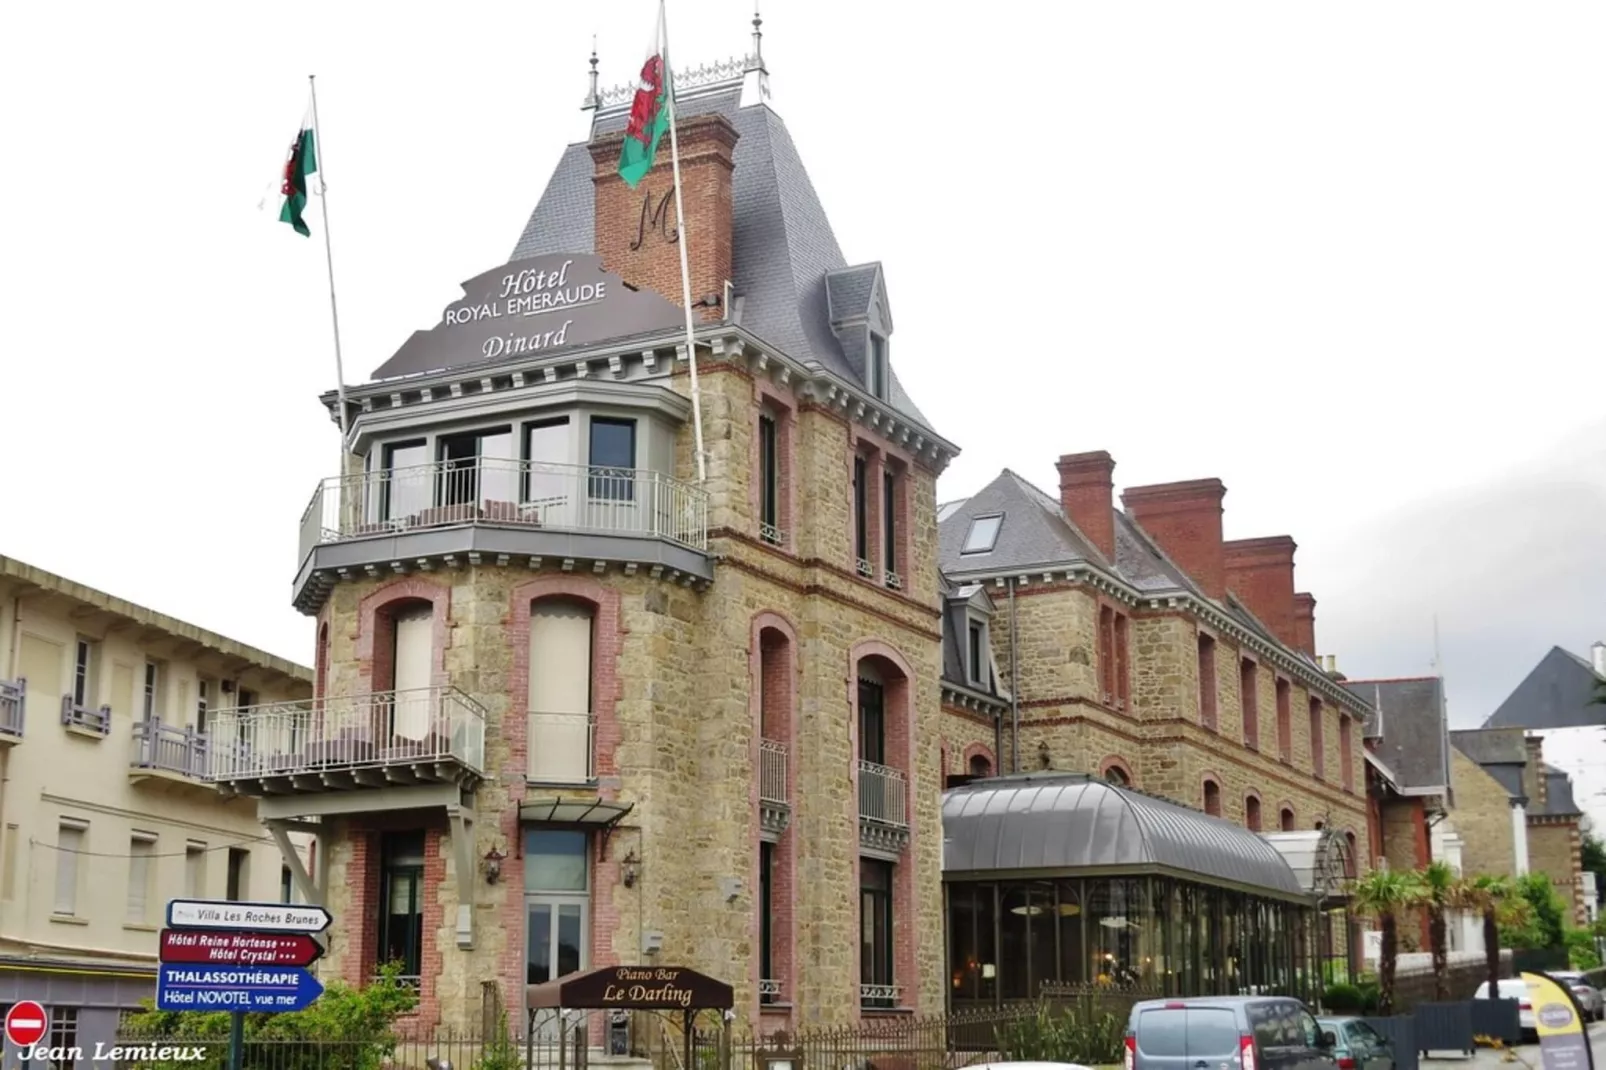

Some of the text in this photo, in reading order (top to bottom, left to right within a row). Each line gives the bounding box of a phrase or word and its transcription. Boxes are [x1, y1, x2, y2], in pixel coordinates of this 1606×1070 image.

[501, 260, 572, 298] Hôtel
[446, 282, 606, 326] ROYAL EMERAUDE
[482, 320, 572, 358] Dinard
[197, 909, 220, 921] Villa
[224, 910, 241, 922] Les
[245, 911, 281, 924] Roches
[285, 913, 319, 925] Brunes
[168, 934, 277, 949] Hôtel Reine Hortense
[209, 948, 277, 964] Hôtel Crystal
[166, 970, 299, 985] THALASSOTHÉRAPIE
[616, 967, 679, 981] Piano Bar
[164, 991, 297, 1005] Hôtel NOVOTEL vue mer
[602, 982, 693, 1007] Le Darling
